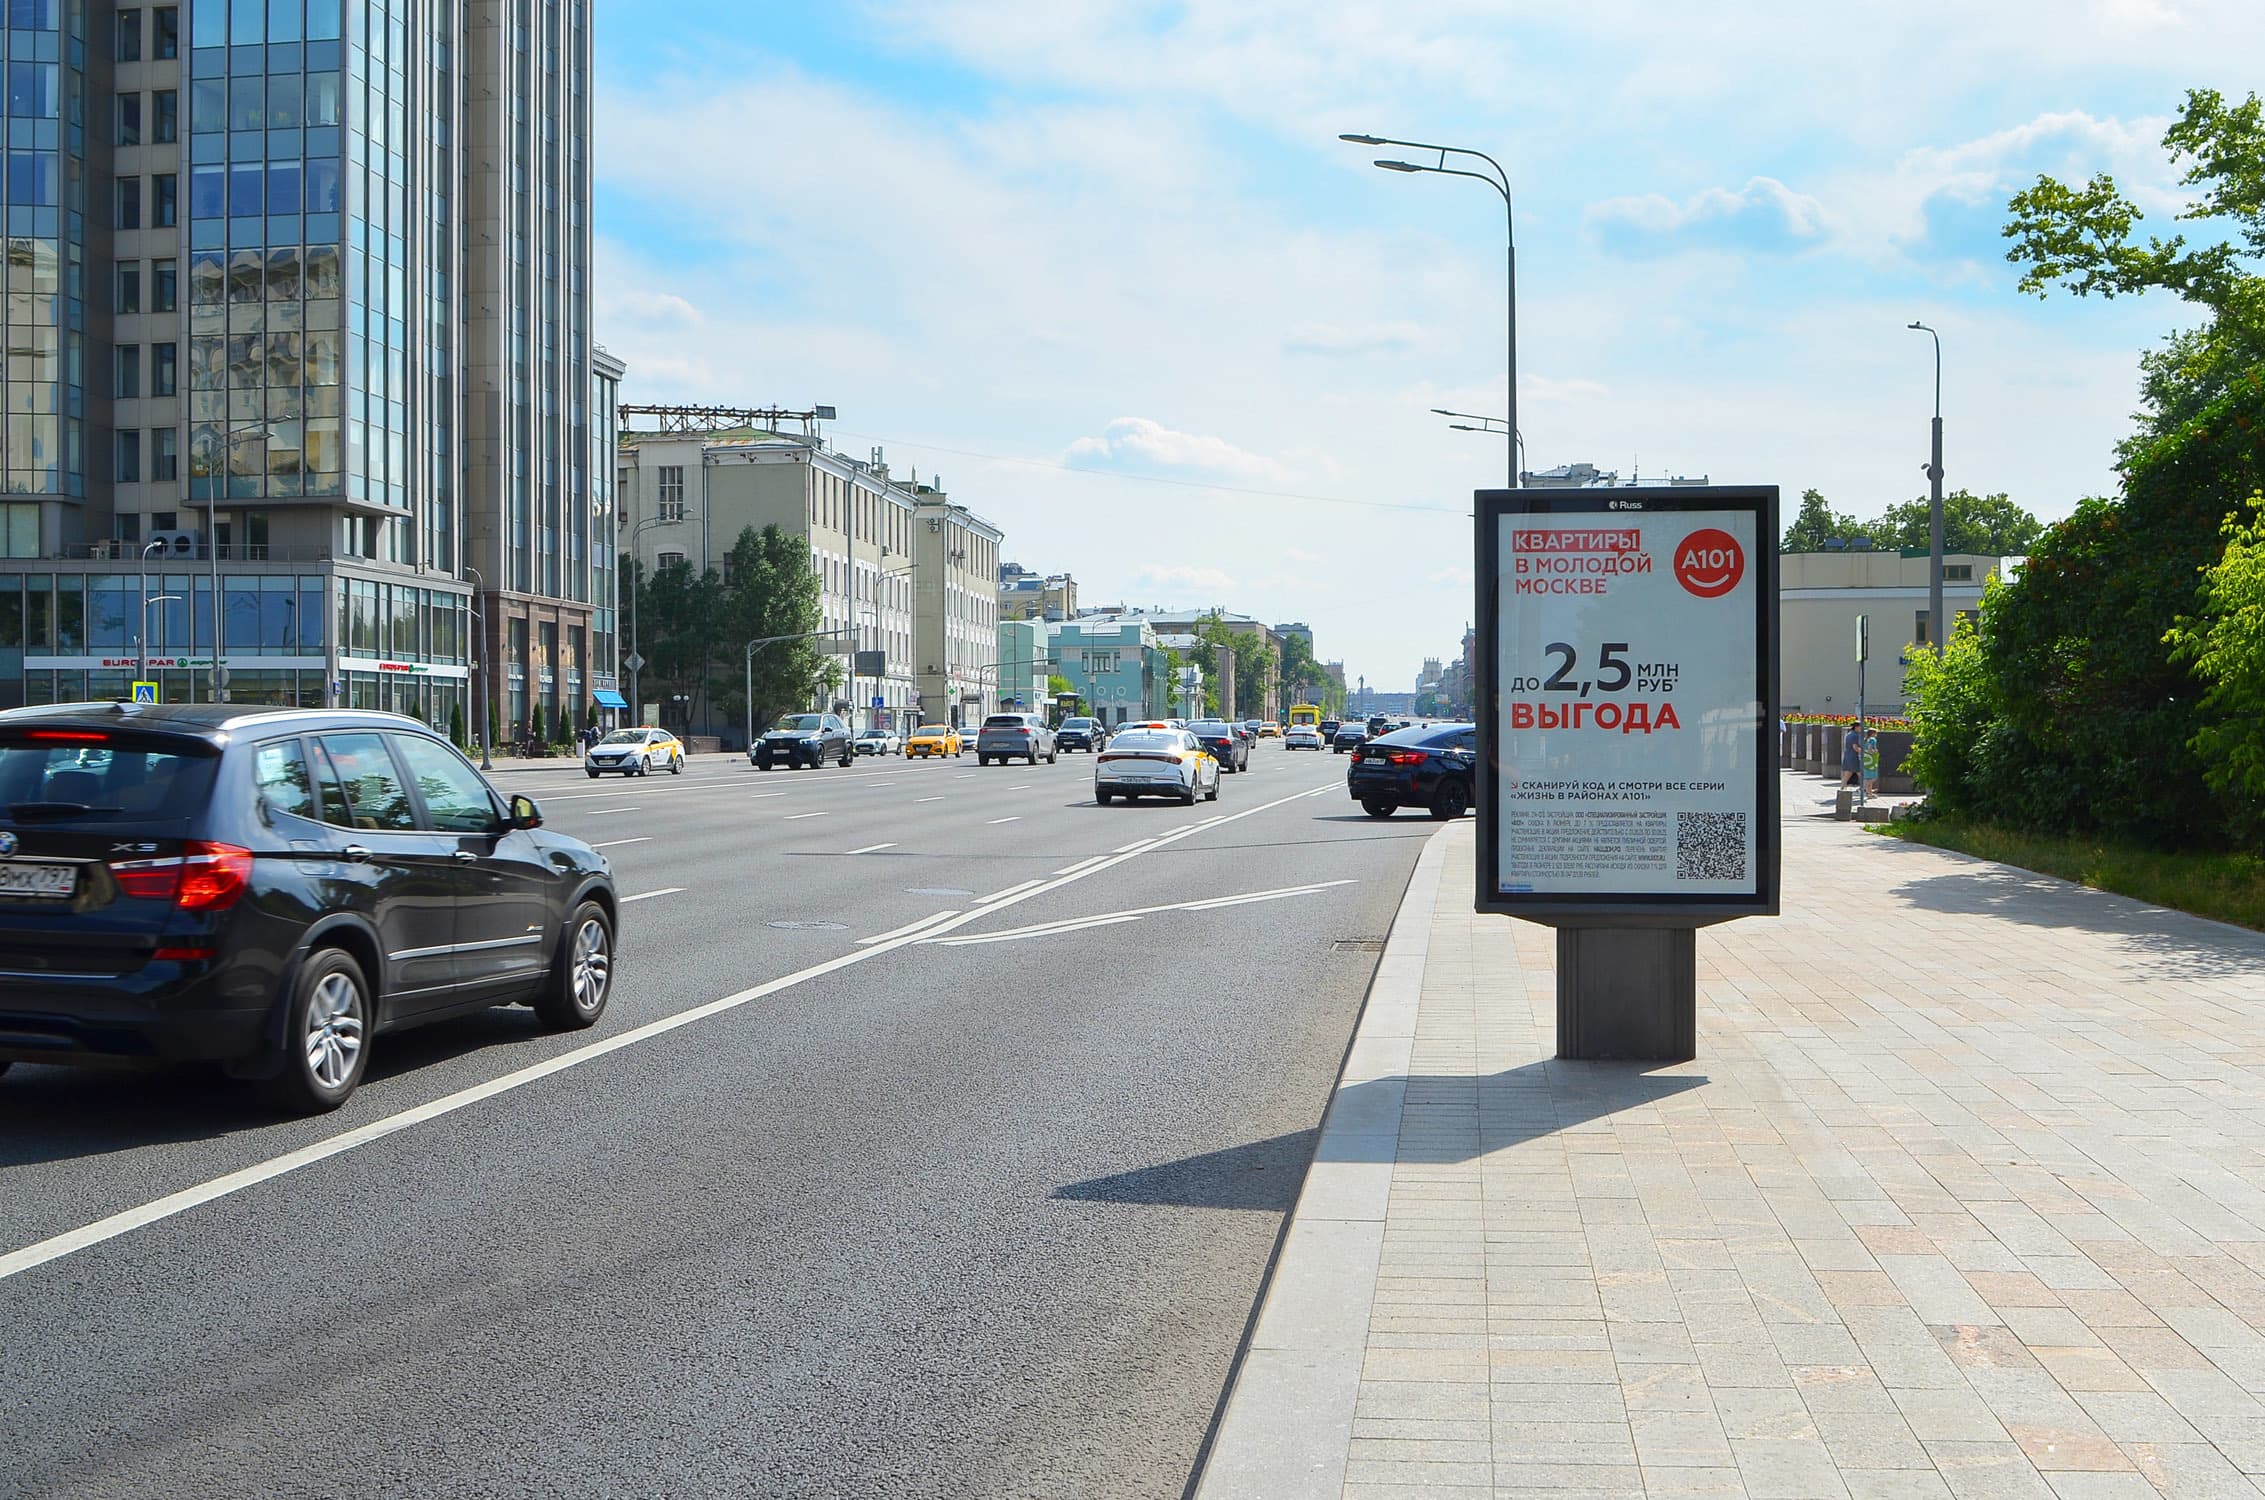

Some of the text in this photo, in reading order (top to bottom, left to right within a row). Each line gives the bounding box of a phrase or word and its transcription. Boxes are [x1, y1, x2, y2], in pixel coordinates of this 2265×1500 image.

[1619, 501, 1642, 509] Russ
[1515, 533, 1636, 550] КВАРТИРЫ
[1515, 553, 1652, 576] В МОЛОДОЙ
[1682, 549, 1735, 569] А101
[1515, 579, 1607, 594] МОСКВЕ
[1511, 642, 1679, 697] ДО 2,5 МЛН
[1511, 702, 1681, 734] ВЫГОДА
[1522, 781, 1725, 791] СКАНИРУЙ КОД И СМОТРИ ВСЕ СЕРИИ
[1510, 792, 1555, 800] «ЖИЗНЬ
[1558, 792, 1564, 800] В
[1568, 790, 1618, 800] РАЙОНАХ
[110, 843, 158, 852] X3
